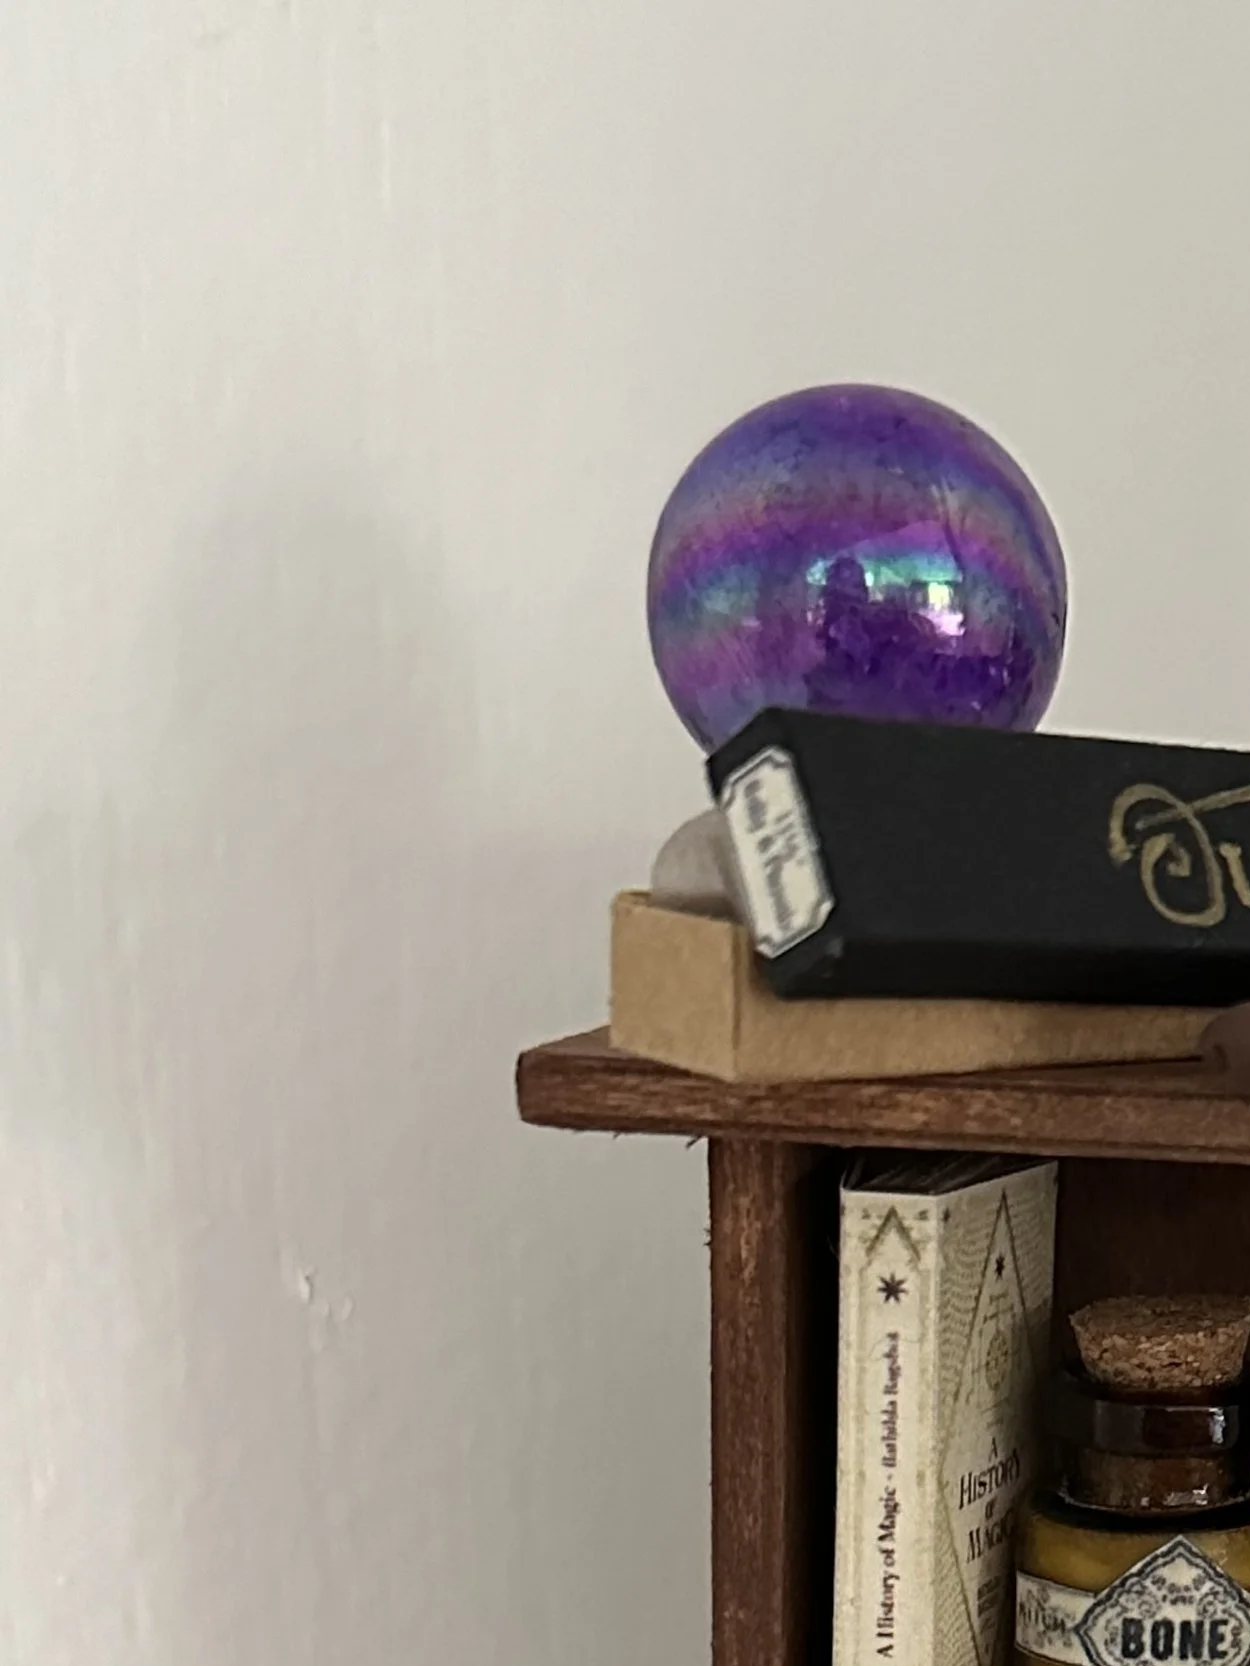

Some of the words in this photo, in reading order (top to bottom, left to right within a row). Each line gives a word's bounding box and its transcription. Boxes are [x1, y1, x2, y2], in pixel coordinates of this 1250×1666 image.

[988, 1436, 999, 1462] A
[877, 1486, 901, 1542] Magic
[879, 1546, 896, 1568] of
[876, 1569, 900, 1639] History
[876, 1643, 894, 1659] A
[1121, 1617, 1229, 1660] BONE
